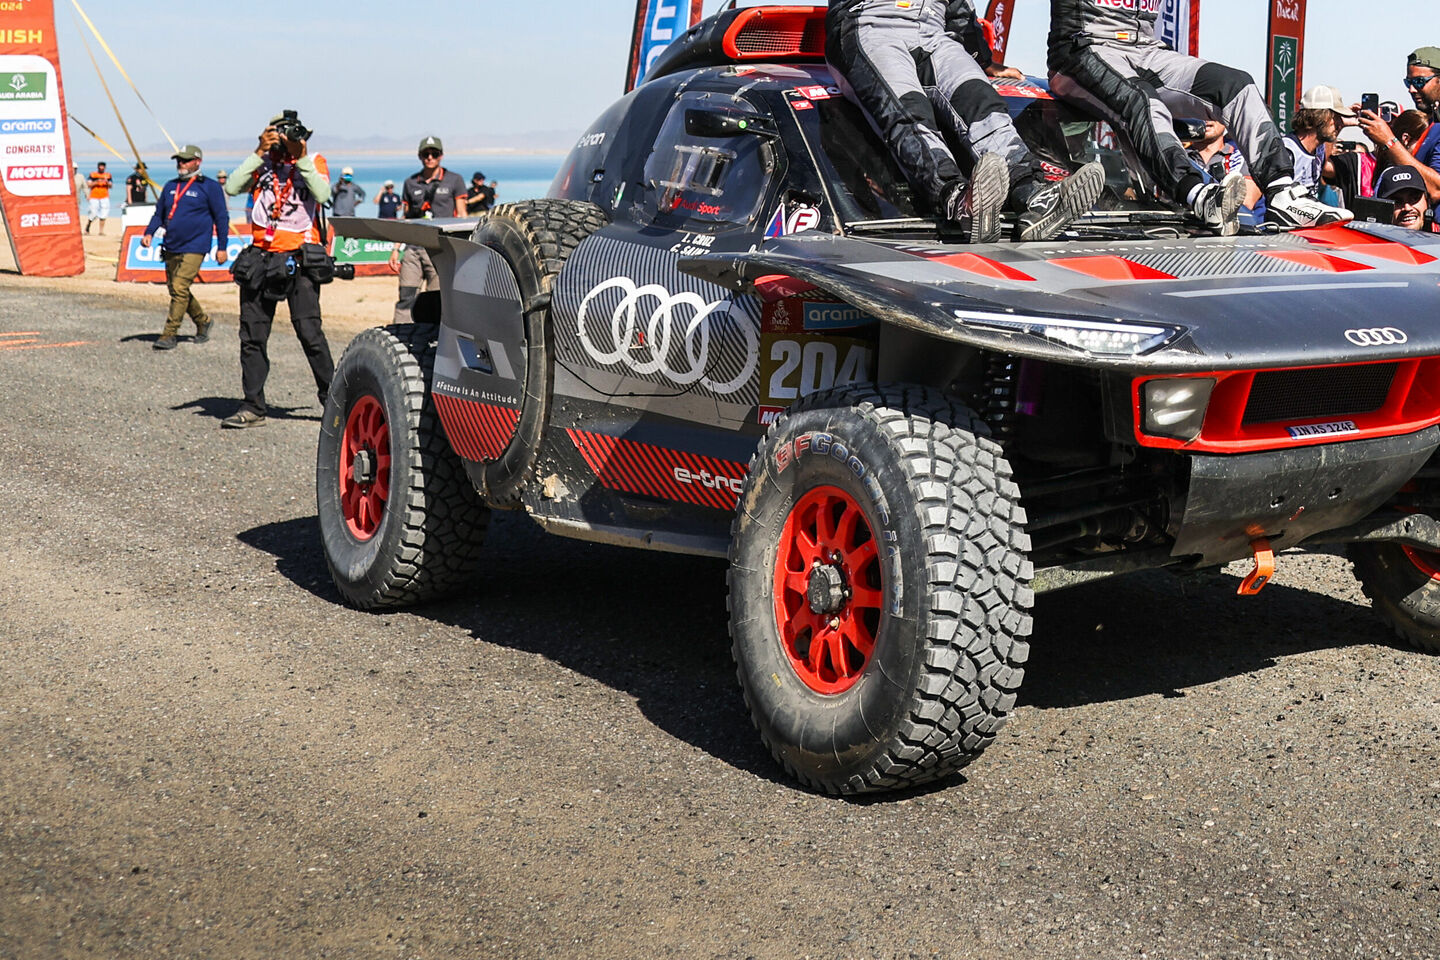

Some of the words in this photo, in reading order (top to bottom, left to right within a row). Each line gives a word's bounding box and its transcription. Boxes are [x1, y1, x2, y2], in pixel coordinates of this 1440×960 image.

[1276, 0, 1299, 21] DAKAR
[2, 123, 52, 131] aramco
[6, 144, 55, 154] CONGRATS!
[10, 167, 61, 179] MOTUL
